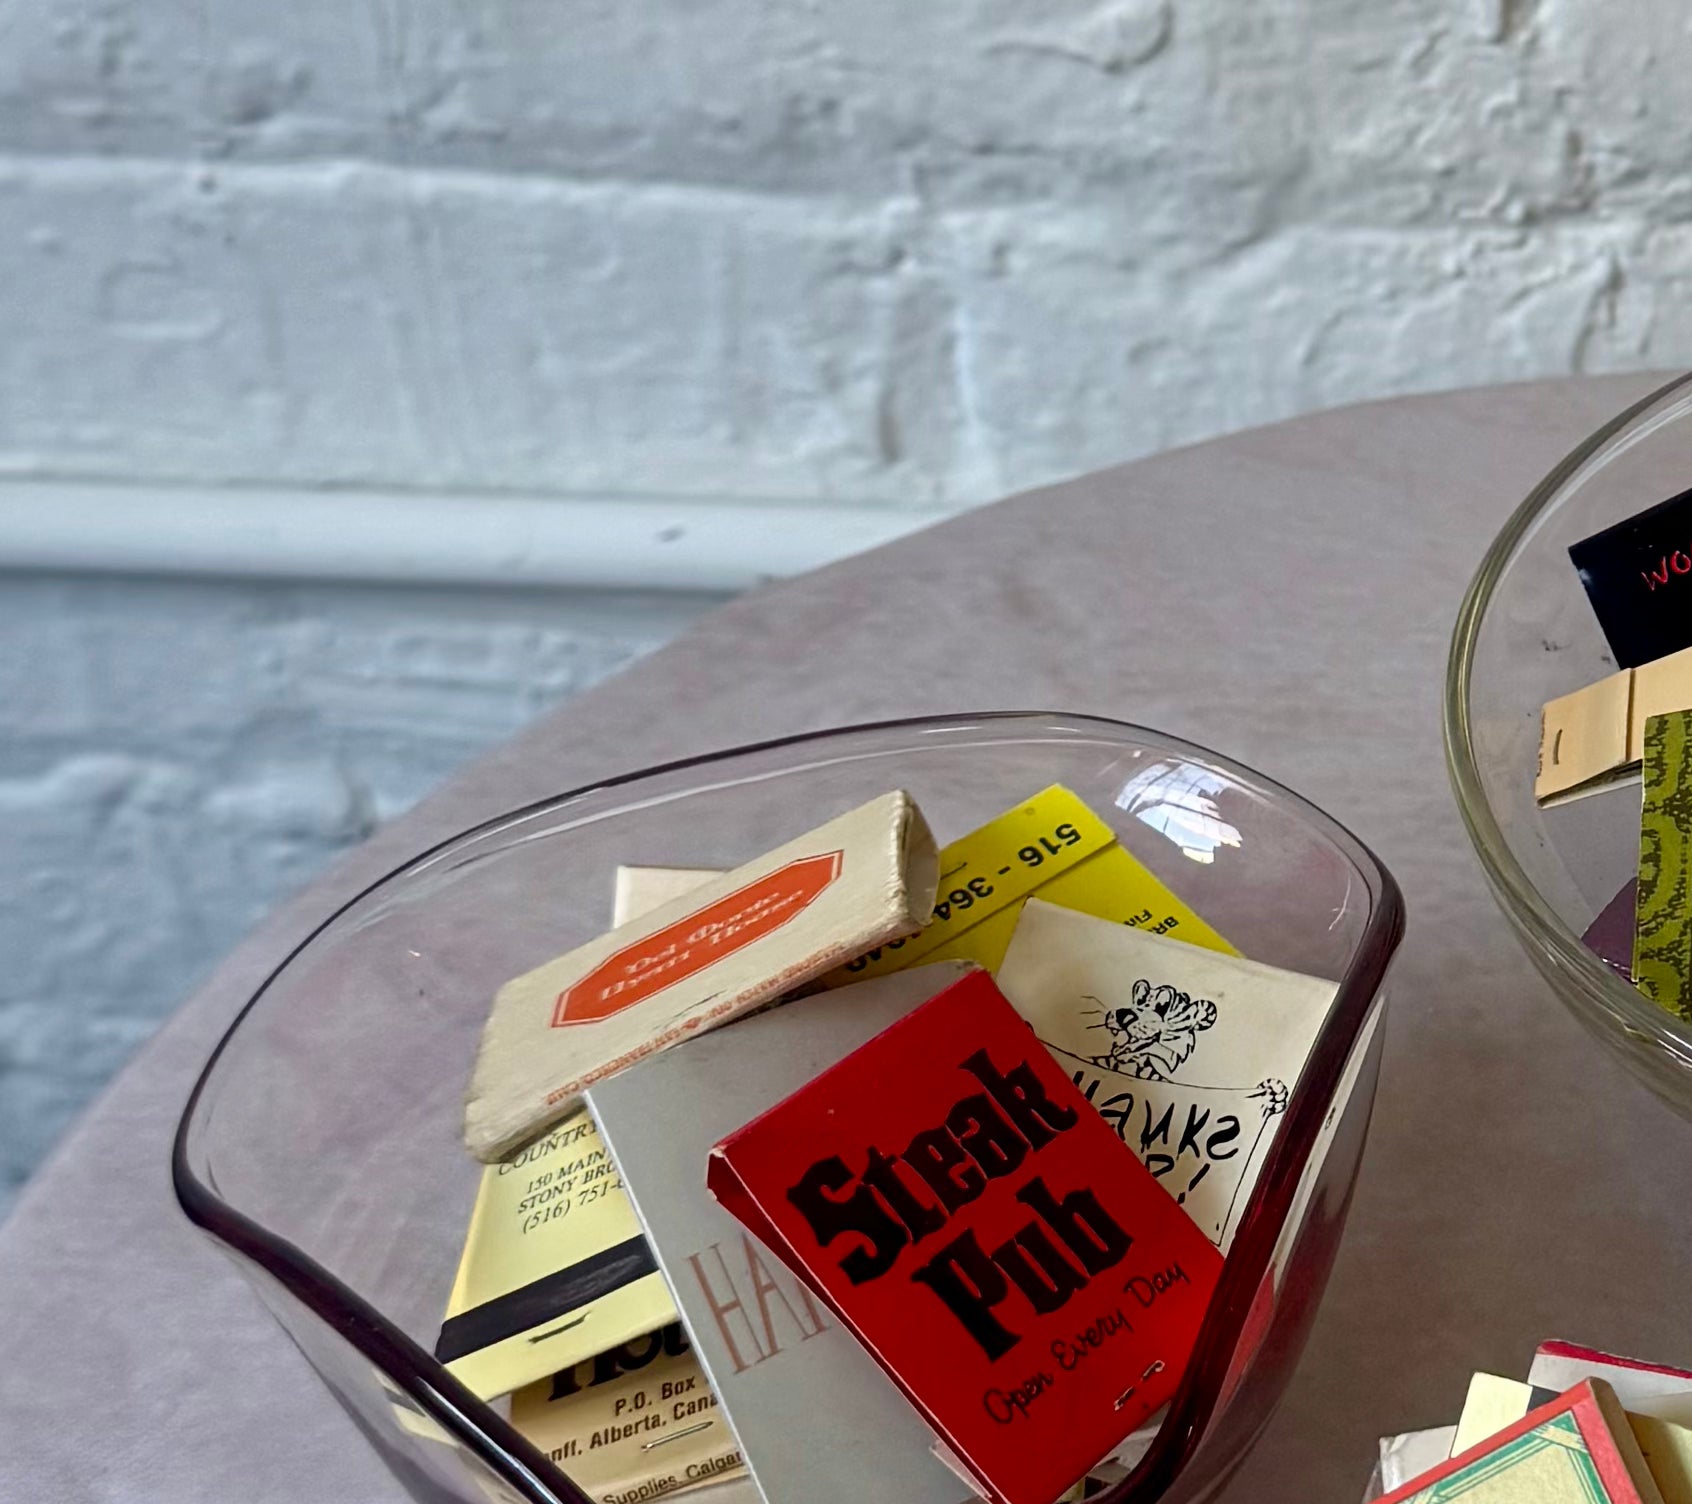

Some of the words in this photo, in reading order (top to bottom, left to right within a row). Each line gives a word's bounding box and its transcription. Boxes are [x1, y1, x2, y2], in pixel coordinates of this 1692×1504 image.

[1018, 822, 1082, 868] 516
[557, 1147, 607, 1181] MAIN
[786, 1047, 1080, 1286] Steak
[517, 1175, 578, 1215] STONY
[522, 1198, 571, 1235] (516)
[911, 1175, 1133, 1363] Pub
[981, 1366, 1056, 1427] Open
[1051, 1306, 1133, 1375] Every
[1125, 1259, 1189, 1323] Day
[614, 1391, 653, 1417] P.O.
[661, 1375, 697, 1401] Box
